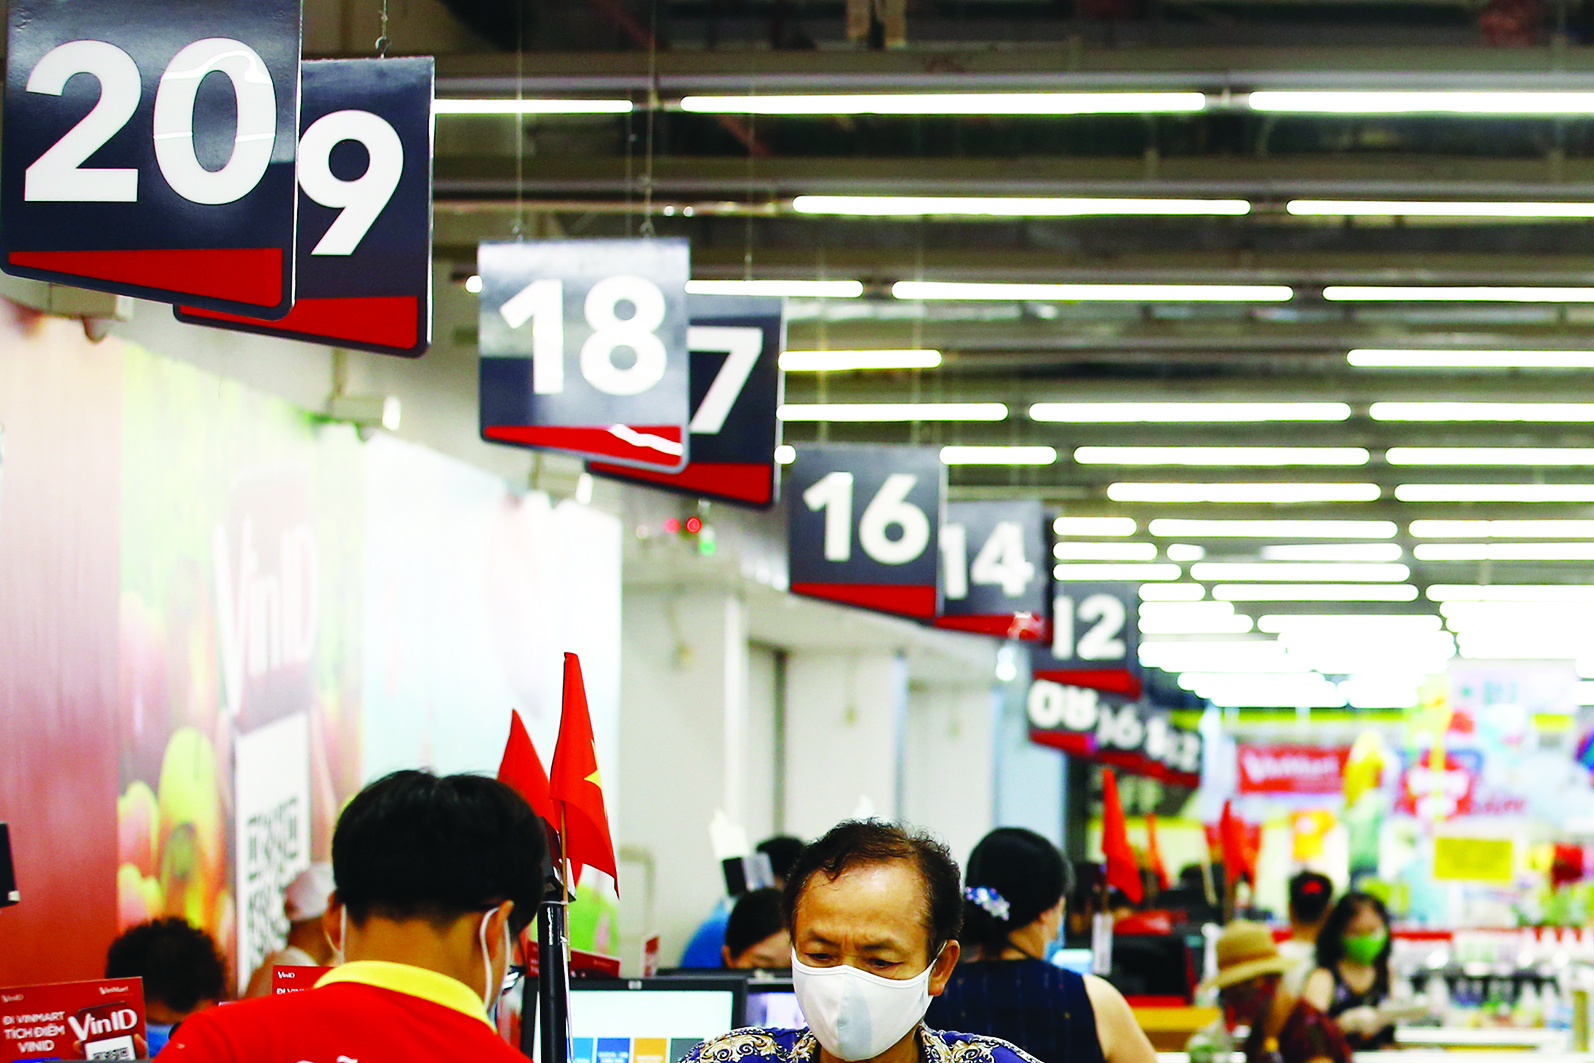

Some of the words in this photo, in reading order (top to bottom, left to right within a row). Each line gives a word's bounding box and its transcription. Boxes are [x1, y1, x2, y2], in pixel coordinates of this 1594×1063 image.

[24, 37, 277, 205] 20
[298, 109, 404, 256] 9
[500, 275, 668, 396] 18
[688, 326, 763, 434] 7
[803, 470, 931, 565] 16
[939, 520, 1035, 600] 14
[1051, 593, 1127, 661] 12
[17, 1011, 65, 1024] VINMART
[17, 1039, 56, 1053] VINID
[67, 1008, 138, 1042] VinID
